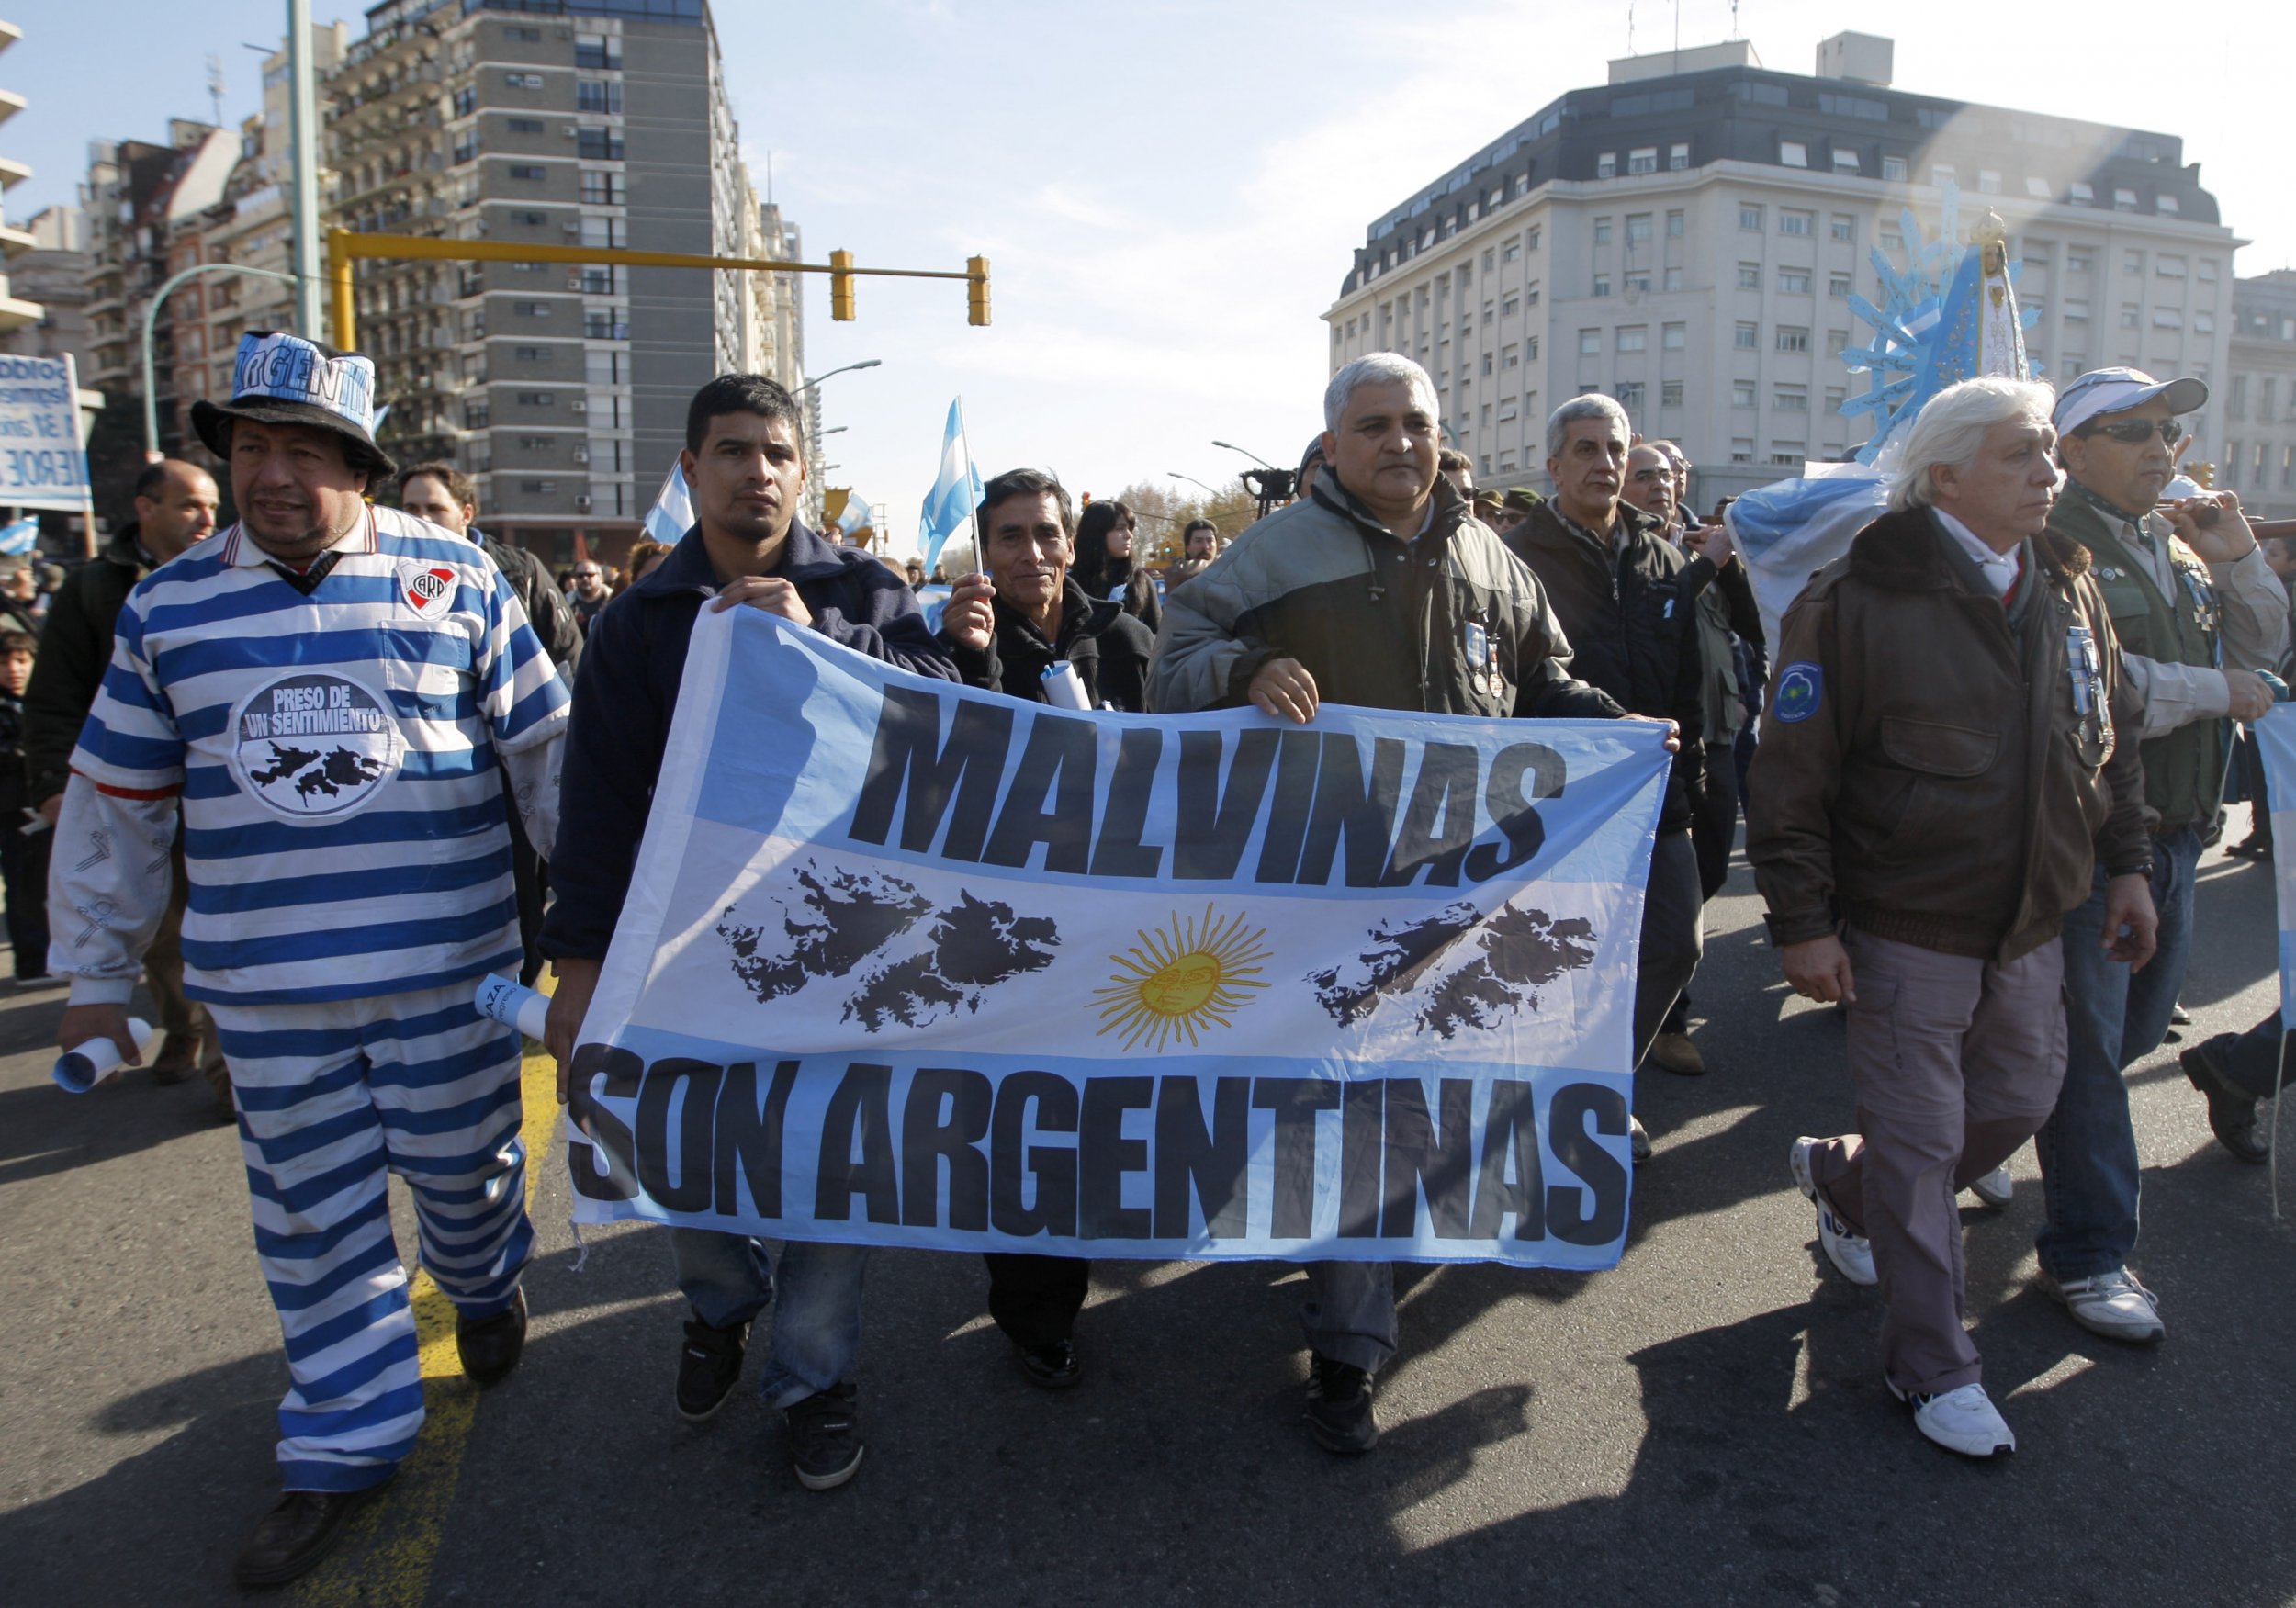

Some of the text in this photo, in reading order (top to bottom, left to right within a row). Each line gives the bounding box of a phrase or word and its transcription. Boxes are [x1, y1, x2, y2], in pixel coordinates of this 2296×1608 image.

[245, 708, 380, 737] UN SENTIMIENTO
[273, 685, 350, 712] PRESO DE
[848, 683, 1567, 889] MALVINAS
[568, 1042, 1628, 1246] SON ARGENTINAS
